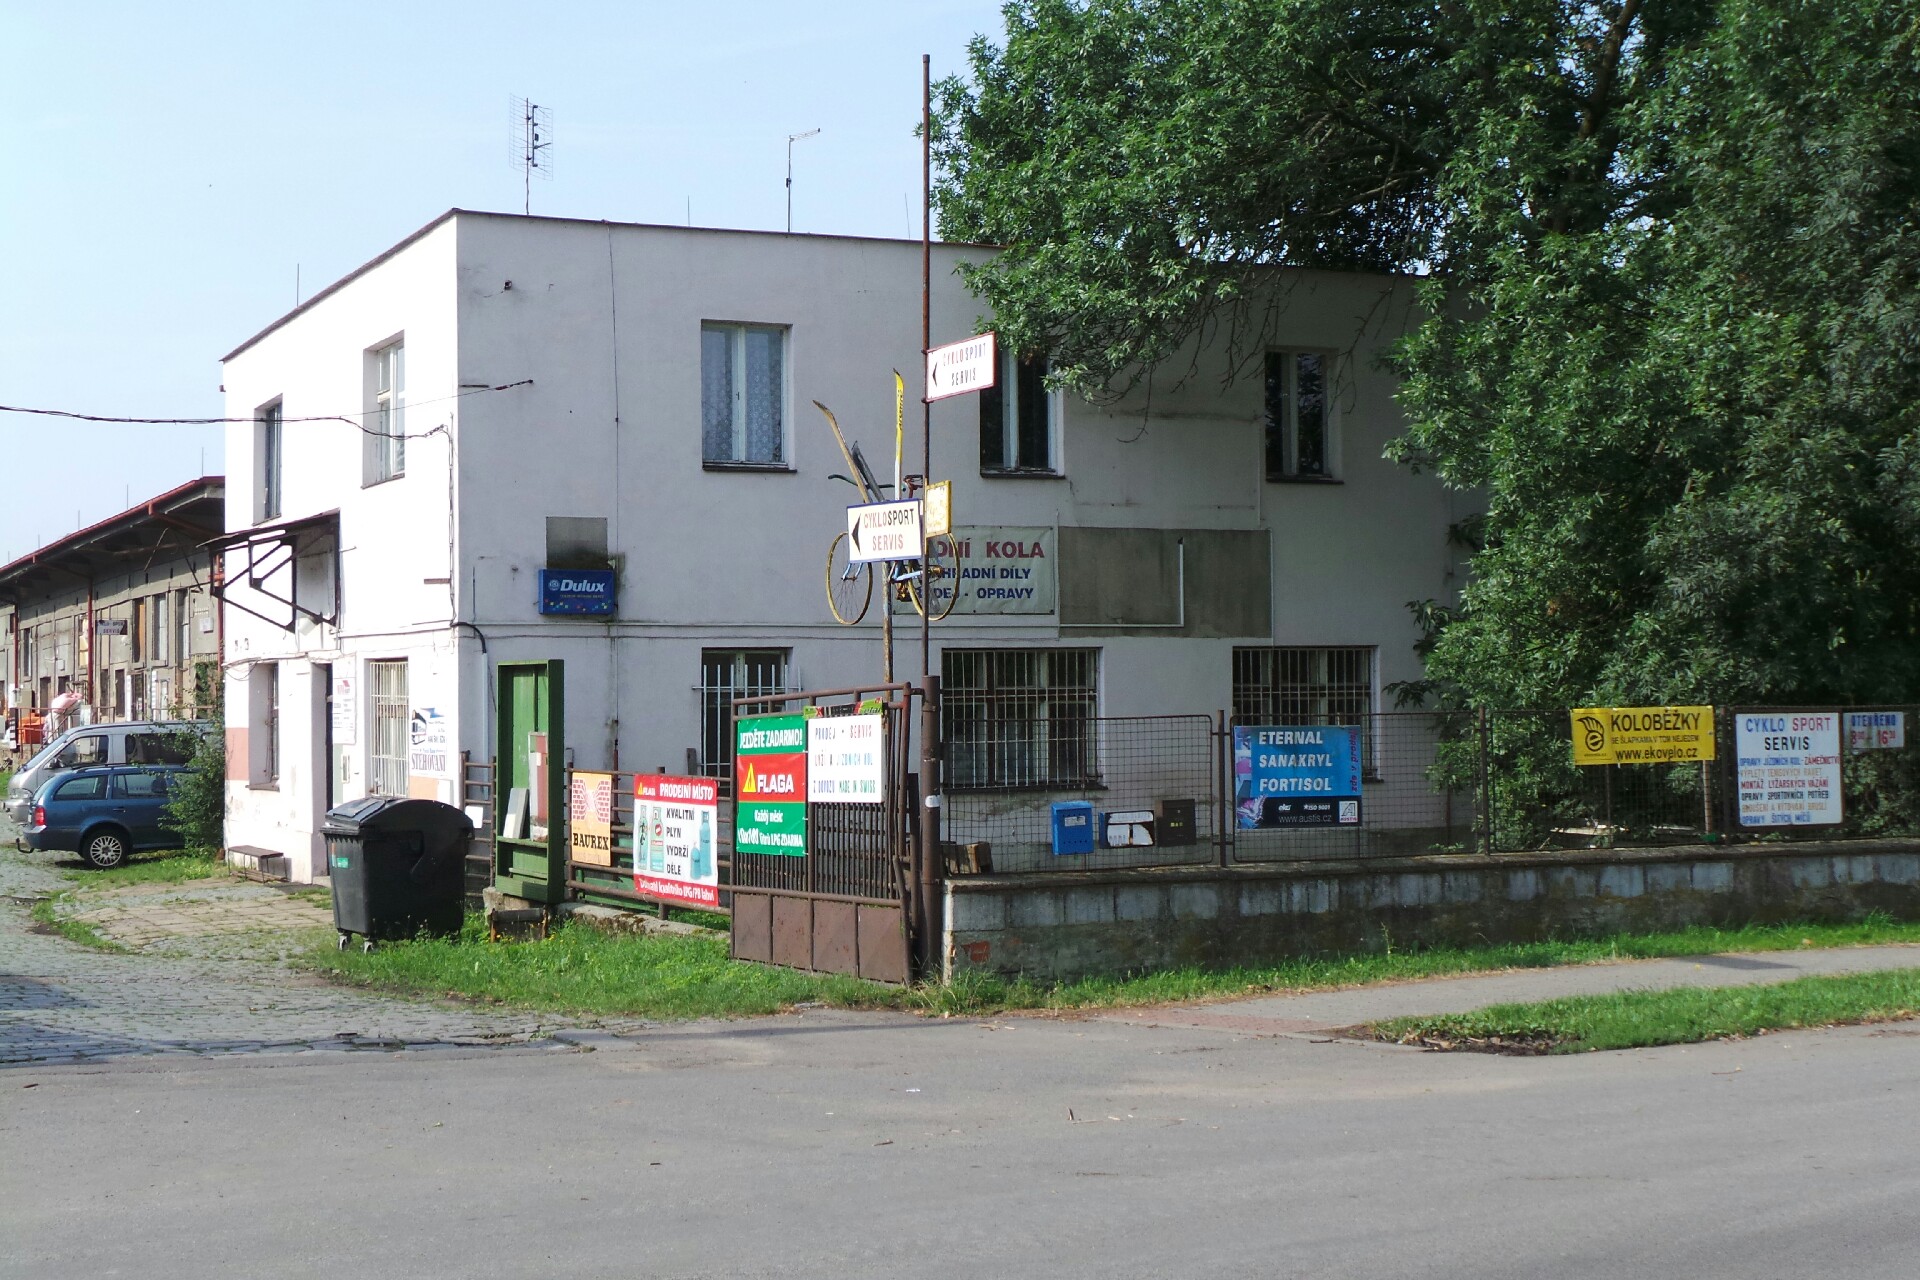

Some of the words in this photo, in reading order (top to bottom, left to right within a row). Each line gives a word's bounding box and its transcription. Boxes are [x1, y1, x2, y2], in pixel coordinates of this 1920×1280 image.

[943, 342, 986, 367] CYKLOSPORT
[951, 367, 976, 387] SERVIS
[864, 508, 915, 528] CYKLOSPORT
[872, 534, 904, 552] SERVIS
[986, 541, 1045, 558] KOLA
[1000, 564, 1032, 580] DÍLY
[560, 579, 606, 592] Dulux
[976, 587, 1034, 599] OPRAVY
[1610, 709, 1701, 732] KOLOBĚŽKY
[1746, 718, 1786, 733] CYKLO
[1792, 717, 1831, 732] SPORT
[740, 728, 765, 749] JEZDĚTE
[766, 729, 803, 748] ZADARMO!
[850, 724, 872, 739] SERVIS
[1258, 731, 1324, 745] ETERNAL
[1659, 735, 1672, 743] TOM
[1672, 734, 1700, 742] NEJEDEM
[1764, 736, 1810, 751] SERVIS
[864, 752, 873, 766] KOL
[1615, 746, 1698, 760] www.ekovelo.cz
[1260, 754, 1333, 768] SANAKRYL
[757, 774, 794, 793] FLAGA
[839, 780, 850, 794] MADE
[852, 780, 857, 793] IN
[860, 780, 876, 794] SWISS
[1260, 778, 1332, 792] FORTISOL
[1349, 775, 1358, 792] zde
[1741, 778, 1764, 790] MONTÁŽ
[660, 783, 691, 799] PRODEJNÍ
[692, 784, 713, 801] MÍSTO
[1742, 792, 1763, 801] OPRAVY
[1768, 788, 1804, 800] SPORTOVNÍCH
[1808, 788, 1829, 799] POTŘEB
[666, 808, 695, 821] KVALITNÍ
[754, 809, 769, 825] Každý
[770, 810, 783, 823] měsíc
[1278, 814, 1332, 823] www.austis.cz
[1742, 815, 1765, 824] OPRAVY
[666, 827, 682, 838] PLYN
[572, 832, 609, 850] BAUREX
[771, 832, 781, 846] LPG
[781, 833, 803, 848] ZDARMA
[666, 844, 689, 858] VYDRŽÍ
[666, 862, 682, 876] DÉLE
